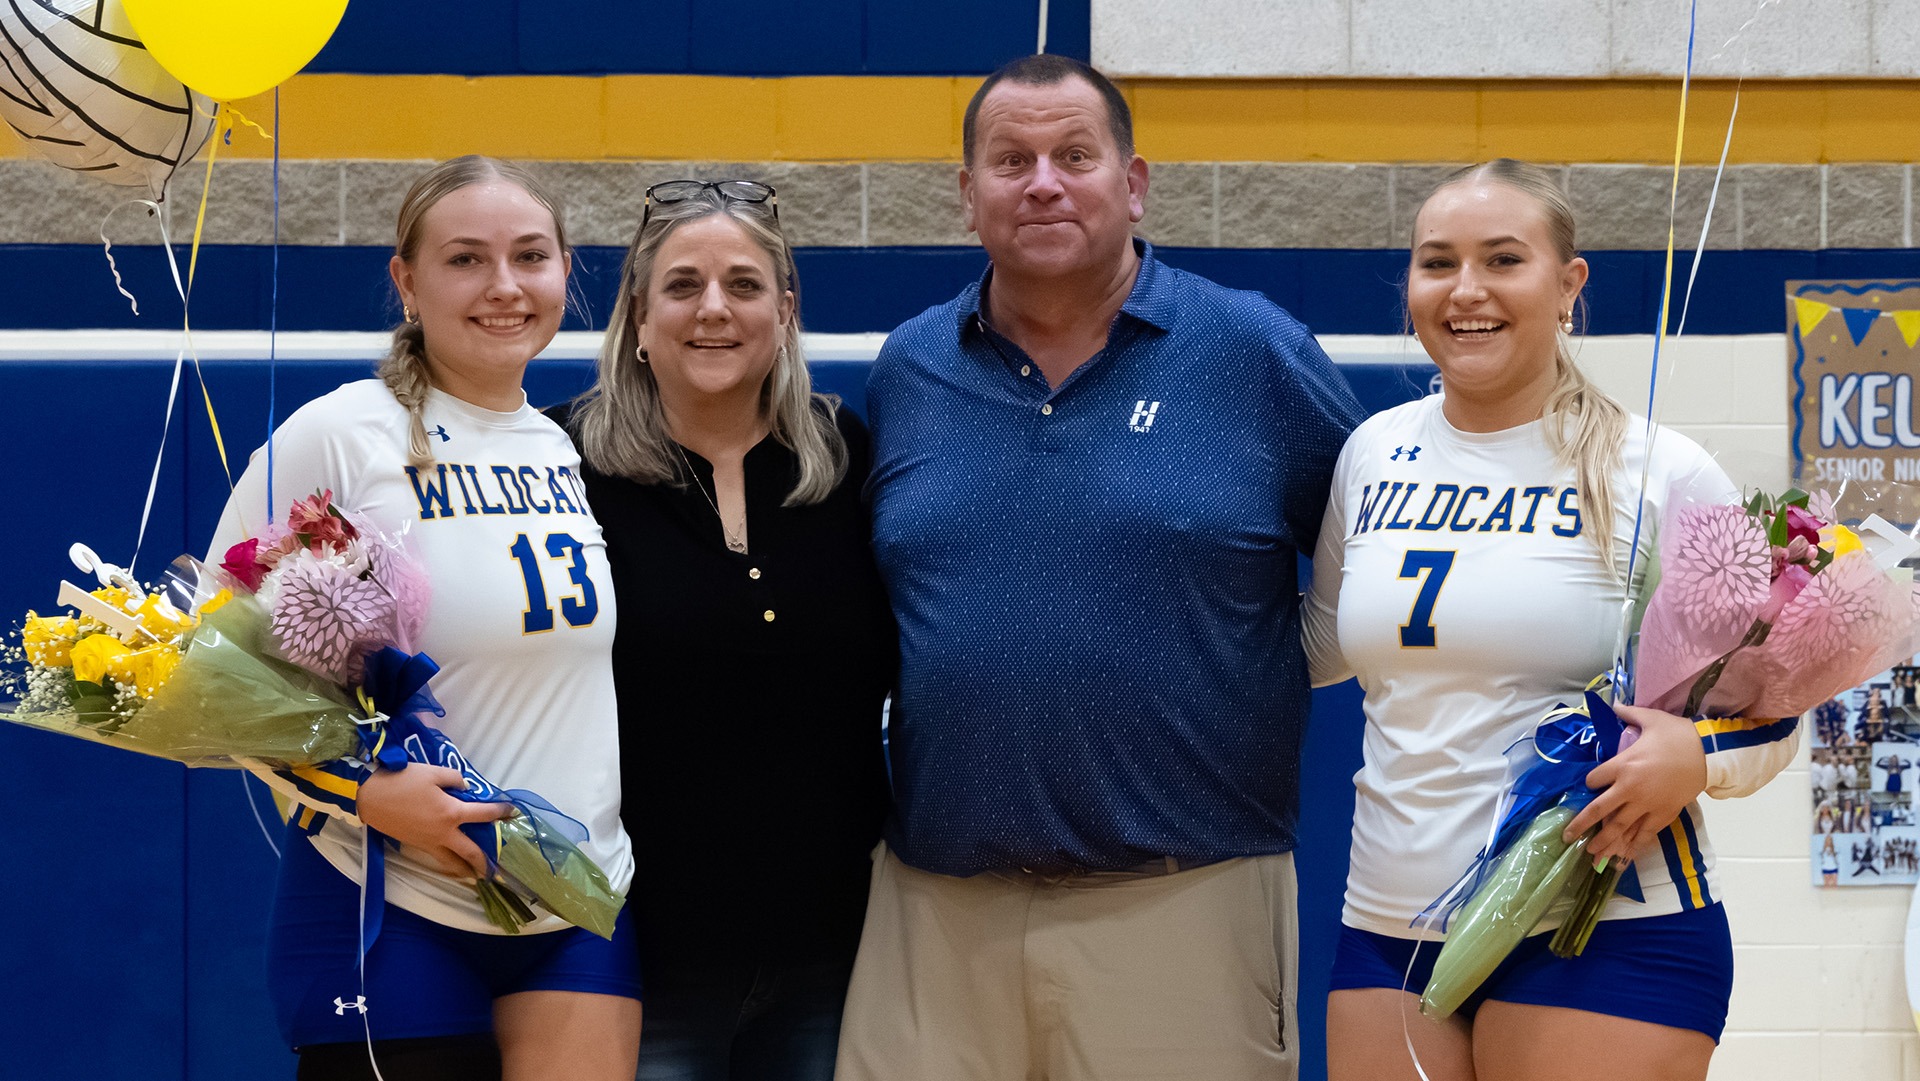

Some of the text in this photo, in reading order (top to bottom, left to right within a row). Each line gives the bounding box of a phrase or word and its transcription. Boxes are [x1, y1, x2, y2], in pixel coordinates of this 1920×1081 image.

[1129, 400, 1160, 427] H
[1819, 372, 1920, 450] KEL
[403, 463, 590, 522] WILDCAT
[1815, 457, 1885, 482] SENIOR
[1352, 480, 1584, 539] WILDCATS
[508, 531, 601, 636] 13
[1396, 547, 1458, 650] 7
